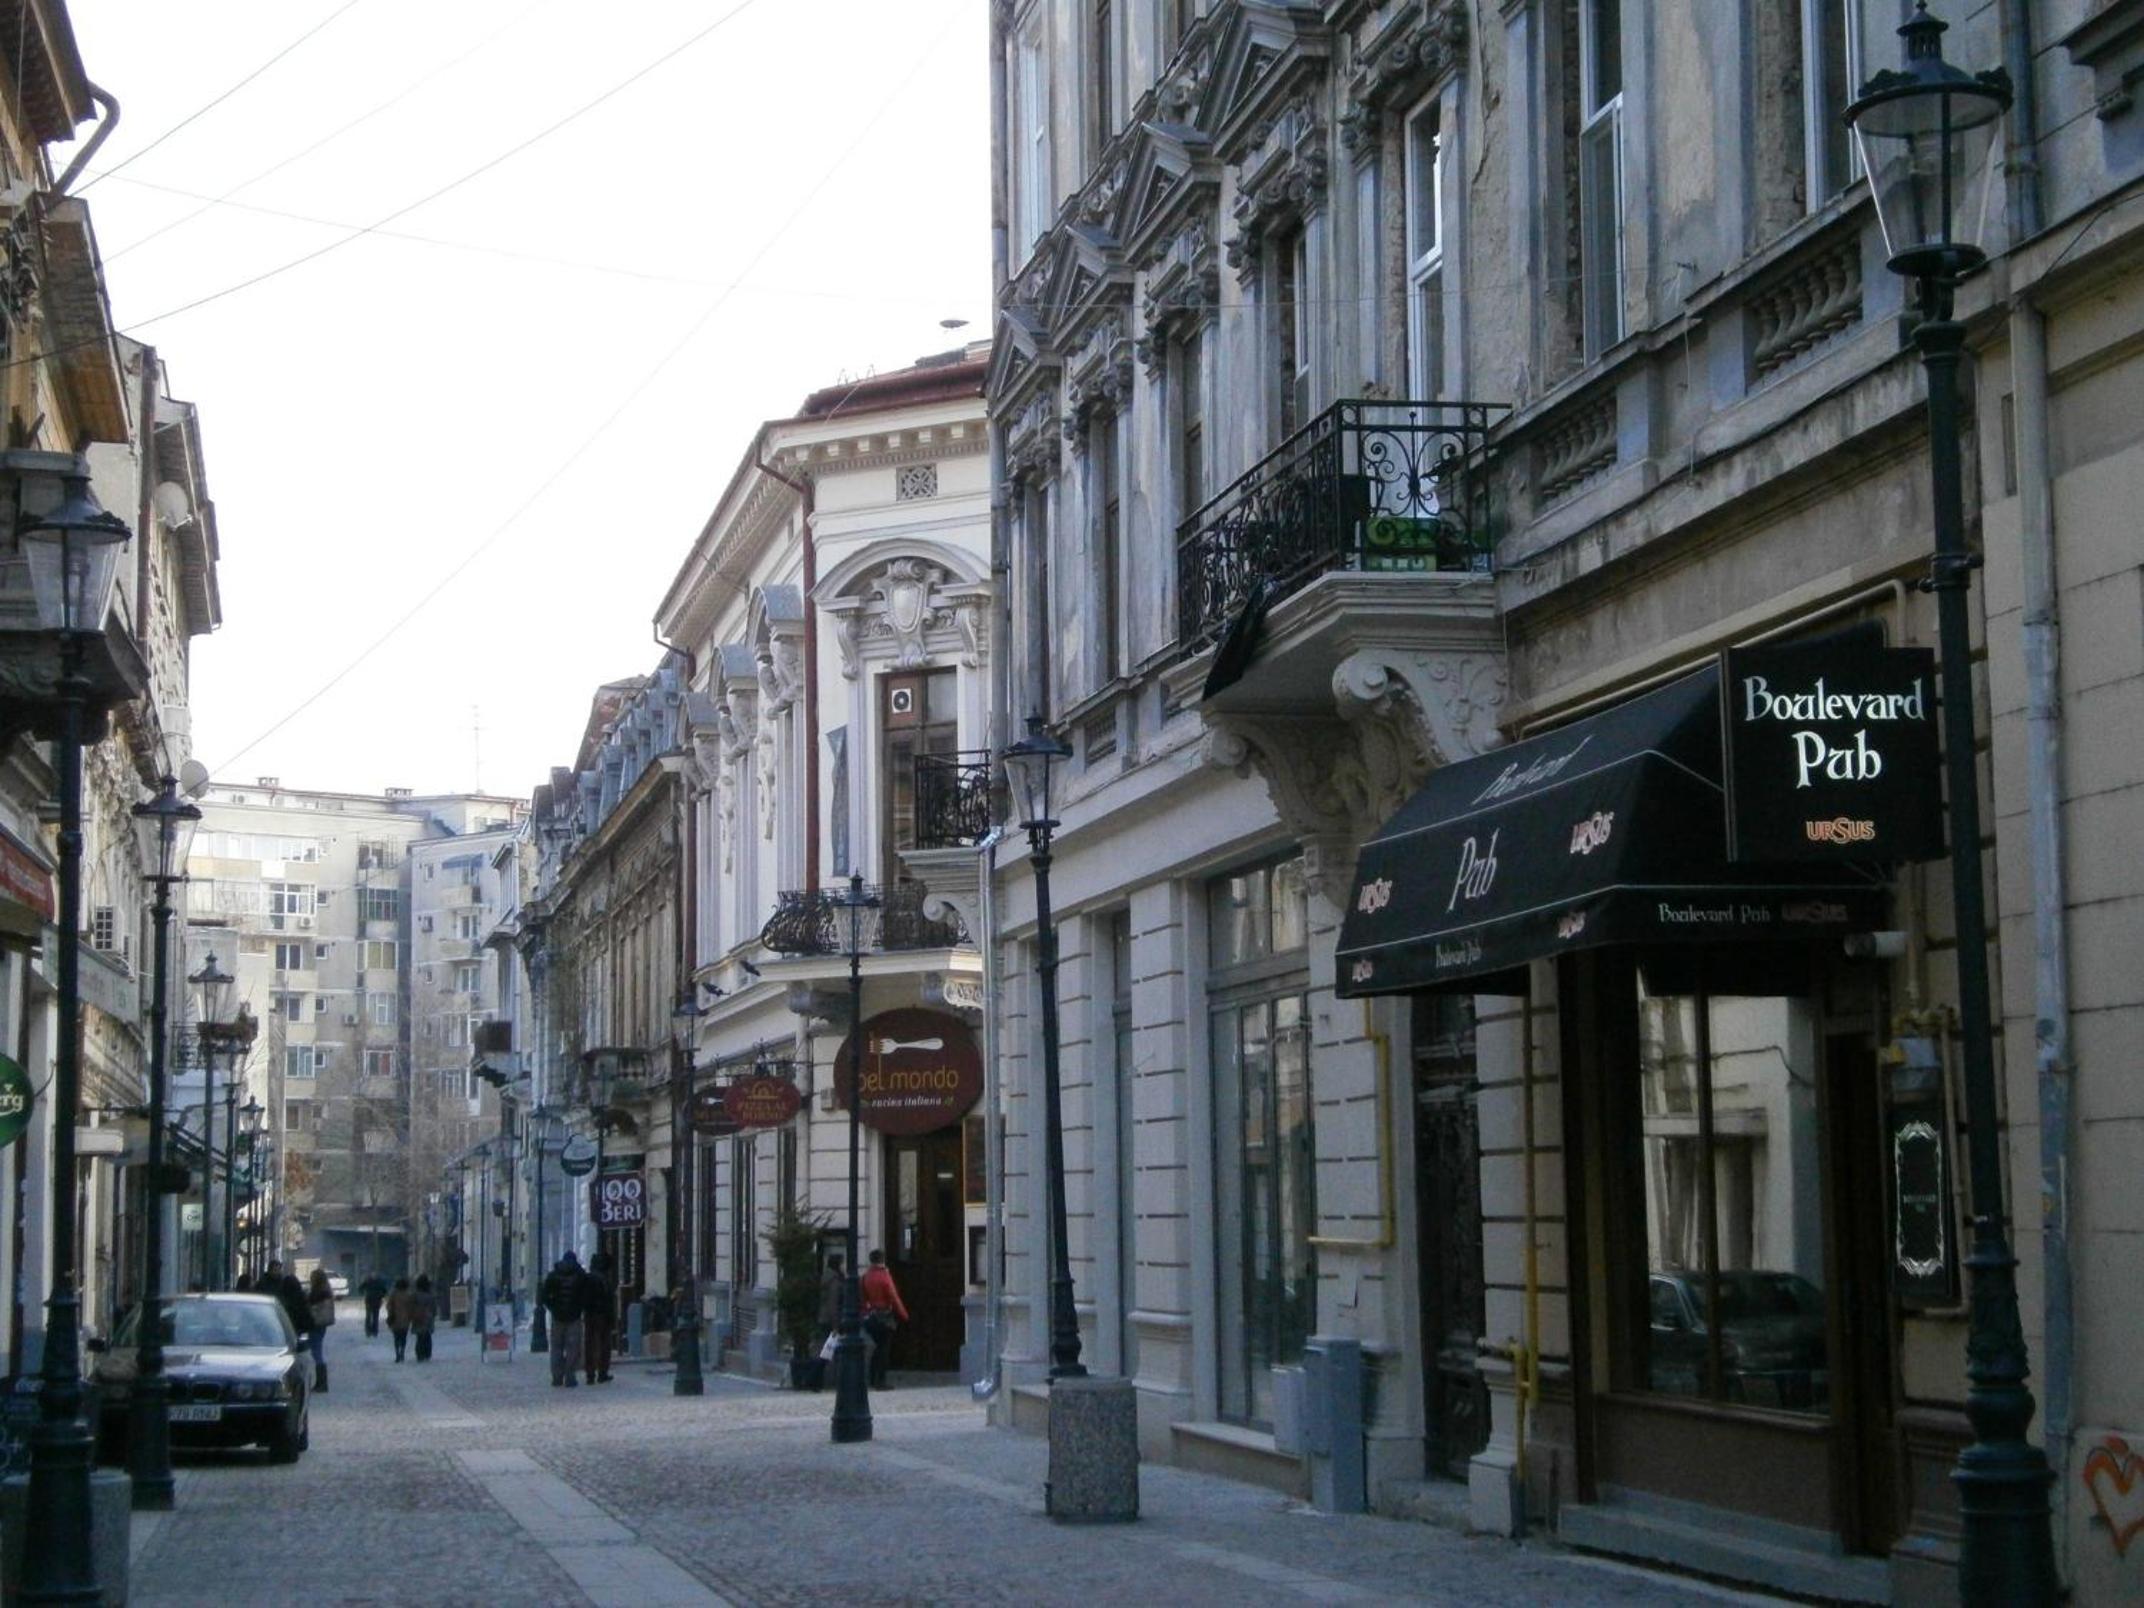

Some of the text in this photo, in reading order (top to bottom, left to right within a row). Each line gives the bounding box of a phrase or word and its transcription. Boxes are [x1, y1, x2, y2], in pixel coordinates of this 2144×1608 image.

[1743, 675, 1925, 721] Boulevard
[1791, 728, 1882, 789] Pub
[1805, 816, 1876, 844] URSUS
[1447, 828, 1500, 912] Pub
[1658, 902, 1734, 923] Boulevard
[1740, 903, 1771, 924] Pub
[889, 1064, 959, 1090] mondo
